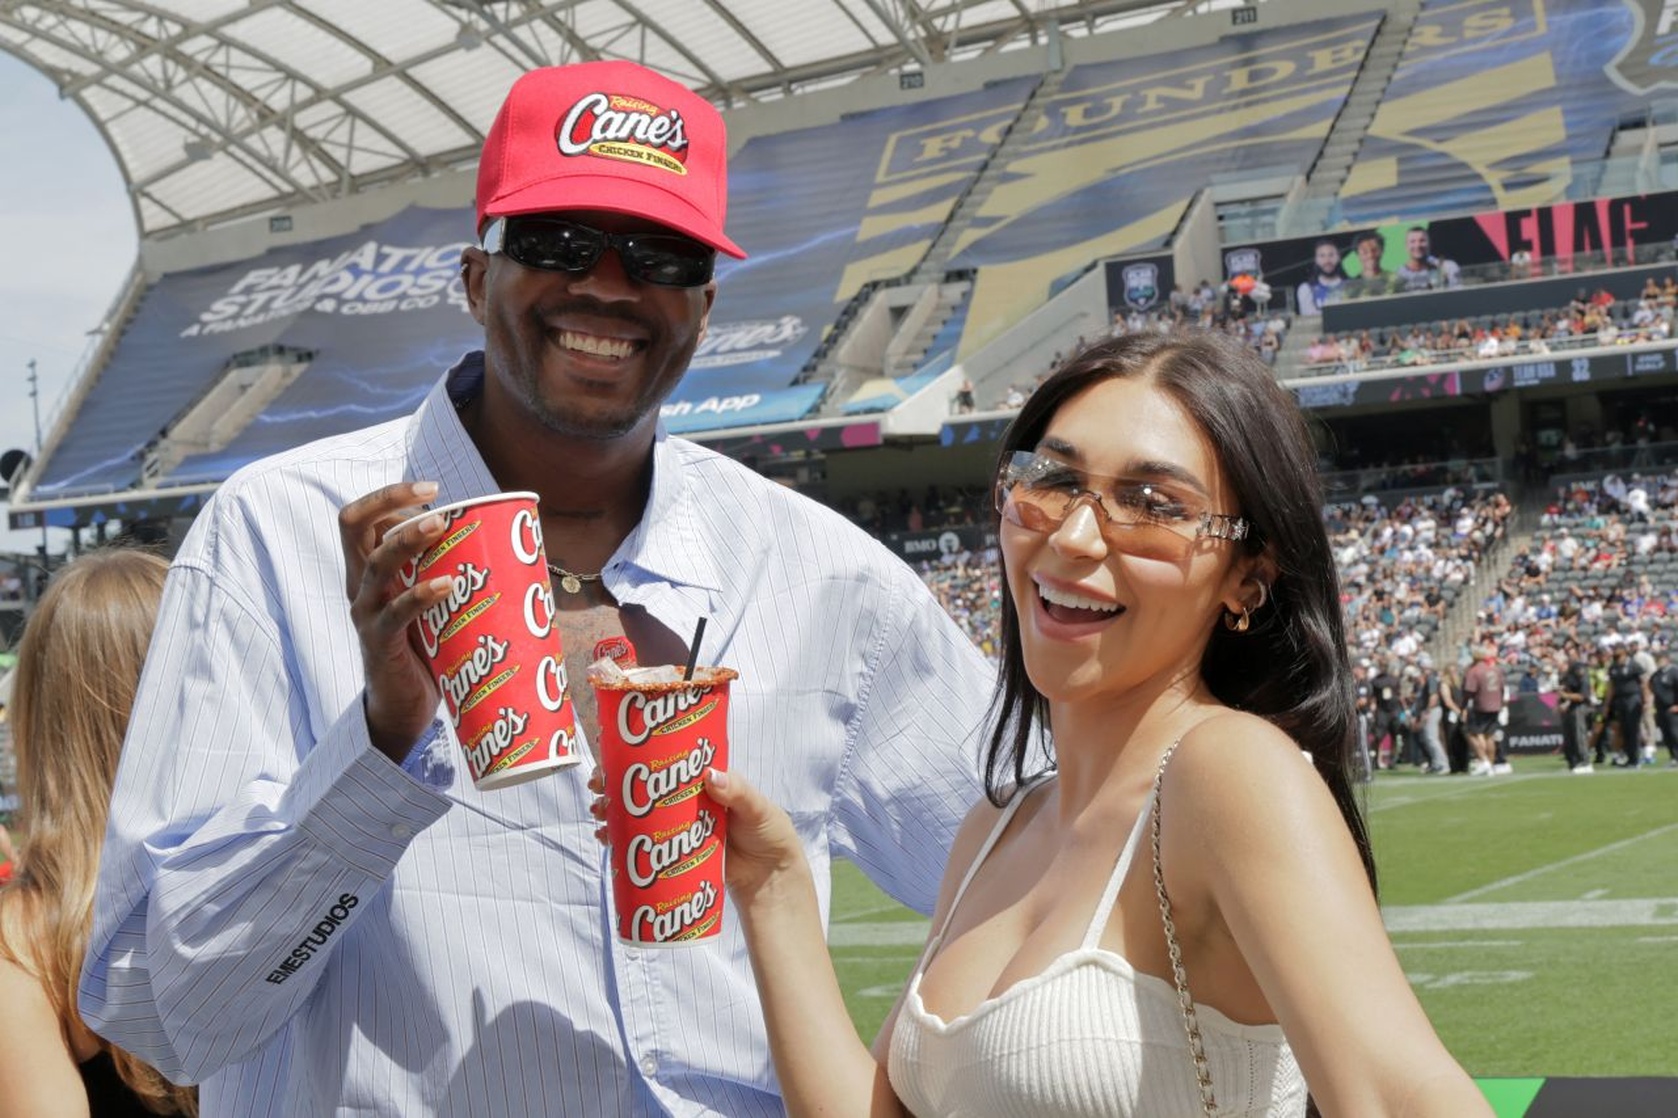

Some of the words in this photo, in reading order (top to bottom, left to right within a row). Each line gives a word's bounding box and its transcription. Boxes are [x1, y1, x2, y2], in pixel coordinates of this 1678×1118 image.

[558, 92, 689, 155] Cane's
[609, 95, 658, 115] Raising
[599, 144, 644, 160] CHICKEN
[693, 393, 761, 415] App
[439, 634, 509, 729] Cane's
[621, 737, 717, 817] Cane's
[650, 750, 690, 772] Raising
[627, 809, 716, 888] Cane's
[654, 821, 692, 843] Raising
[631, 880, 718, 943] Cane's
[657, 892, 693, 913] Raising
[265, 892, 360, 986] EMESTUDIOS
